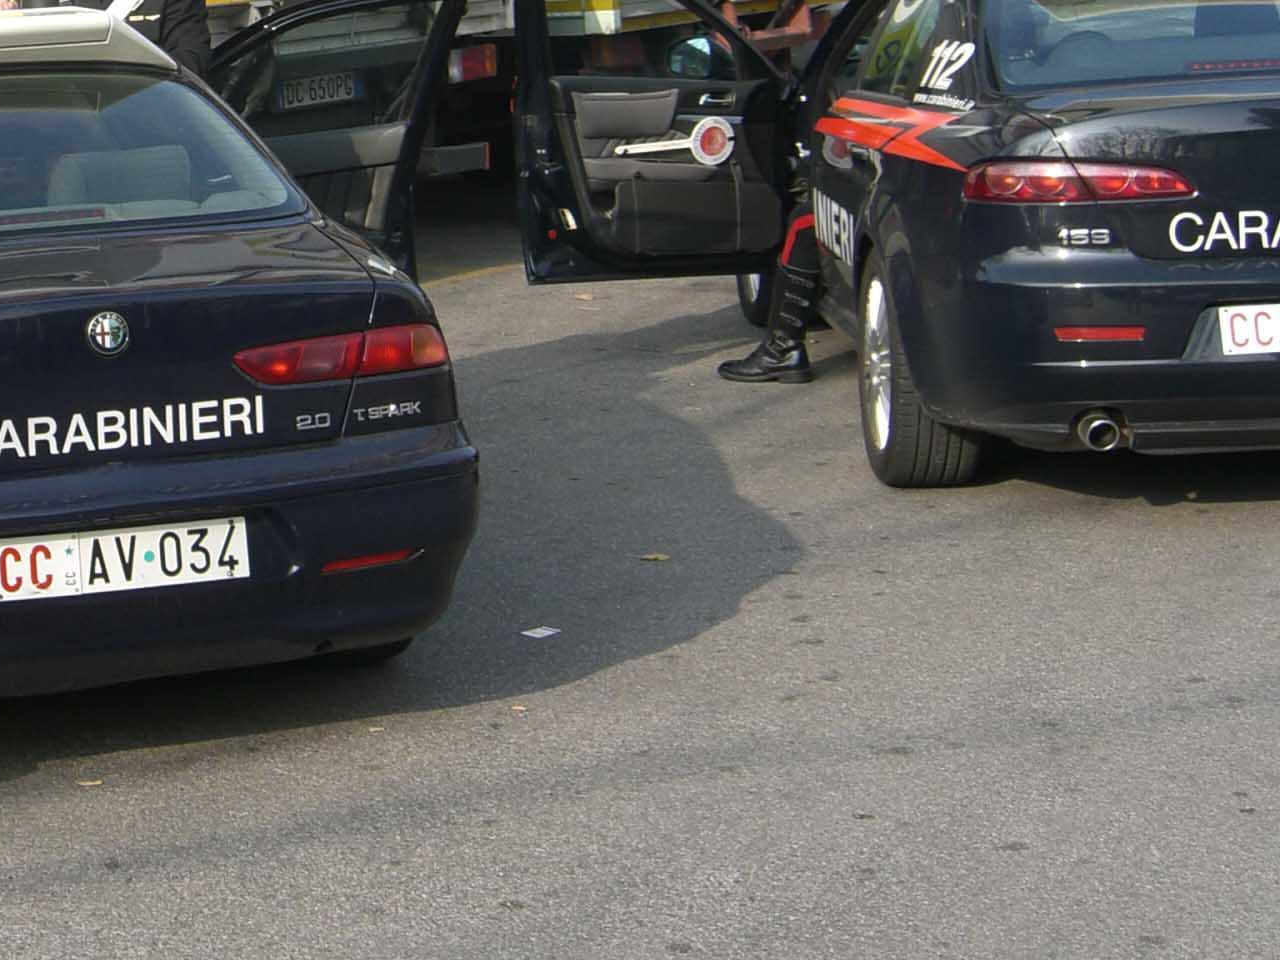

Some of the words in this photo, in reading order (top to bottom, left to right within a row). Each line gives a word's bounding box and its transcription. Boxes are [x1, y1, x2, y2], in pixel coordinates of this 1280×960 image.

[920, 39, 976, 90] 112
[285, 80, 305, 105] DC
[1057, 228, 1111, 246] 159
[1230, 311, 1274, 348] CC
[367, 400, 422, 420] SPARK
[0, 544, 53, 593] CC
